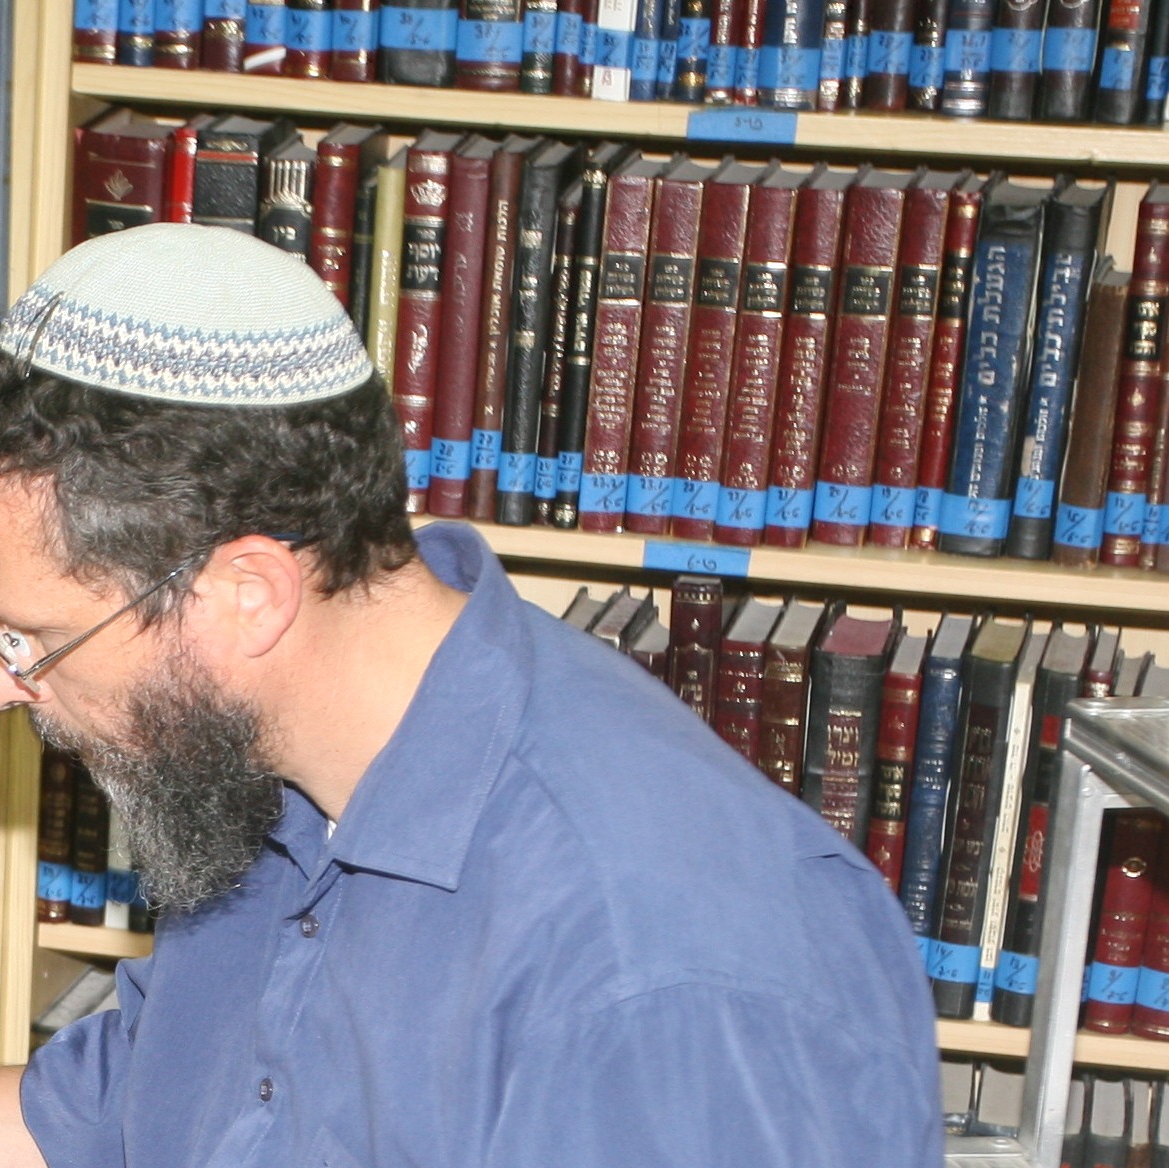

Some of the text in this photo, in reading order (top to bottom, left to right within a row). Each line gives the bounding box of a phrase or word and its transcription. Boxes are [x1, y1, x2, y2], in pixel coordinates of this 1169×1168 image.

[978, 245, 1007, 325] הגעלת
[1042, 253, 1073, 328] טבילת
[976, 330, 998, 386] כלים
[1038, 328, 1063, 388] כלים
